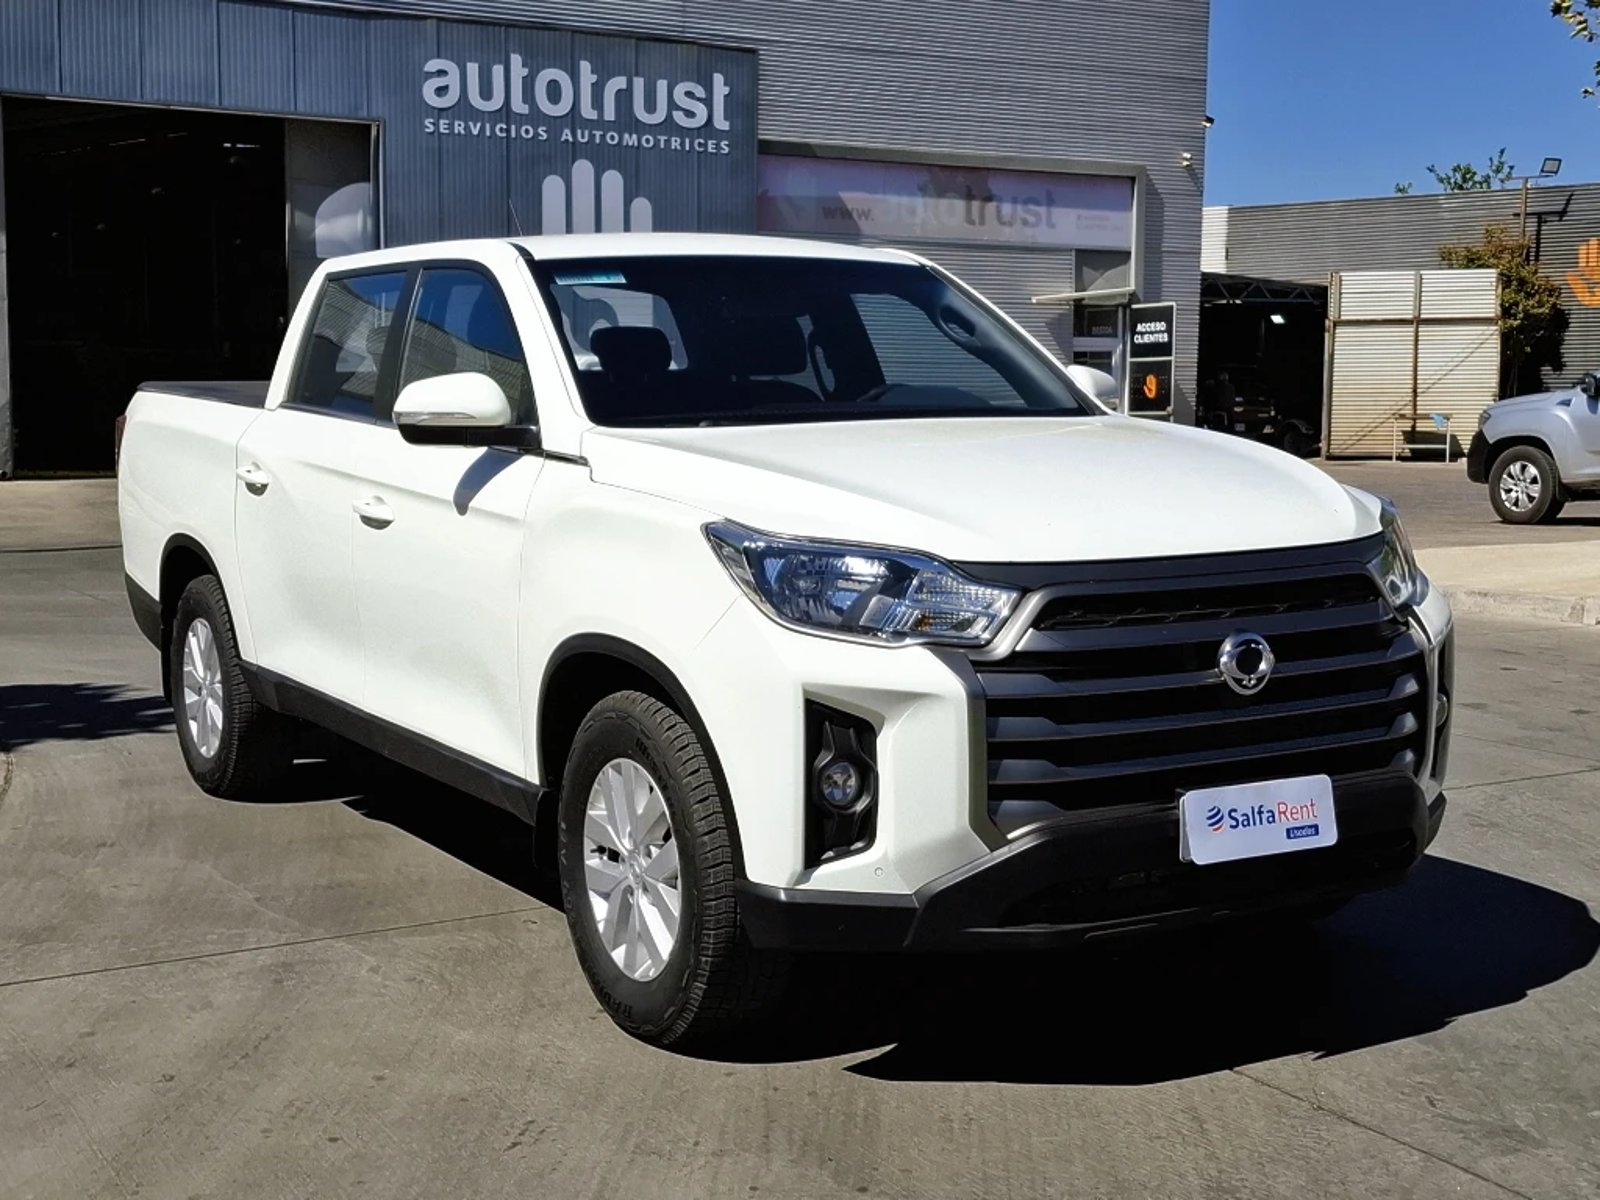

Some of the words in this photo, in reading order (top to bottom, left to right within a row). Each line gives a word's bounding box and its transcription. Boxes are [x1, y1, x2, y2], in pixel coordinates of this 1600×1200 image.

[422, 53, 730, 131] autotrust
[424, 118, 548, 141] SERVICIOS
[561, 128, 730, 154] AUTOMOTRICES
[1134, 333, 1168, 344] CLIENTES
[1136, 321, 1167, 332] ACCESO
[1228, 798, 1318, 830] SalfaRent
